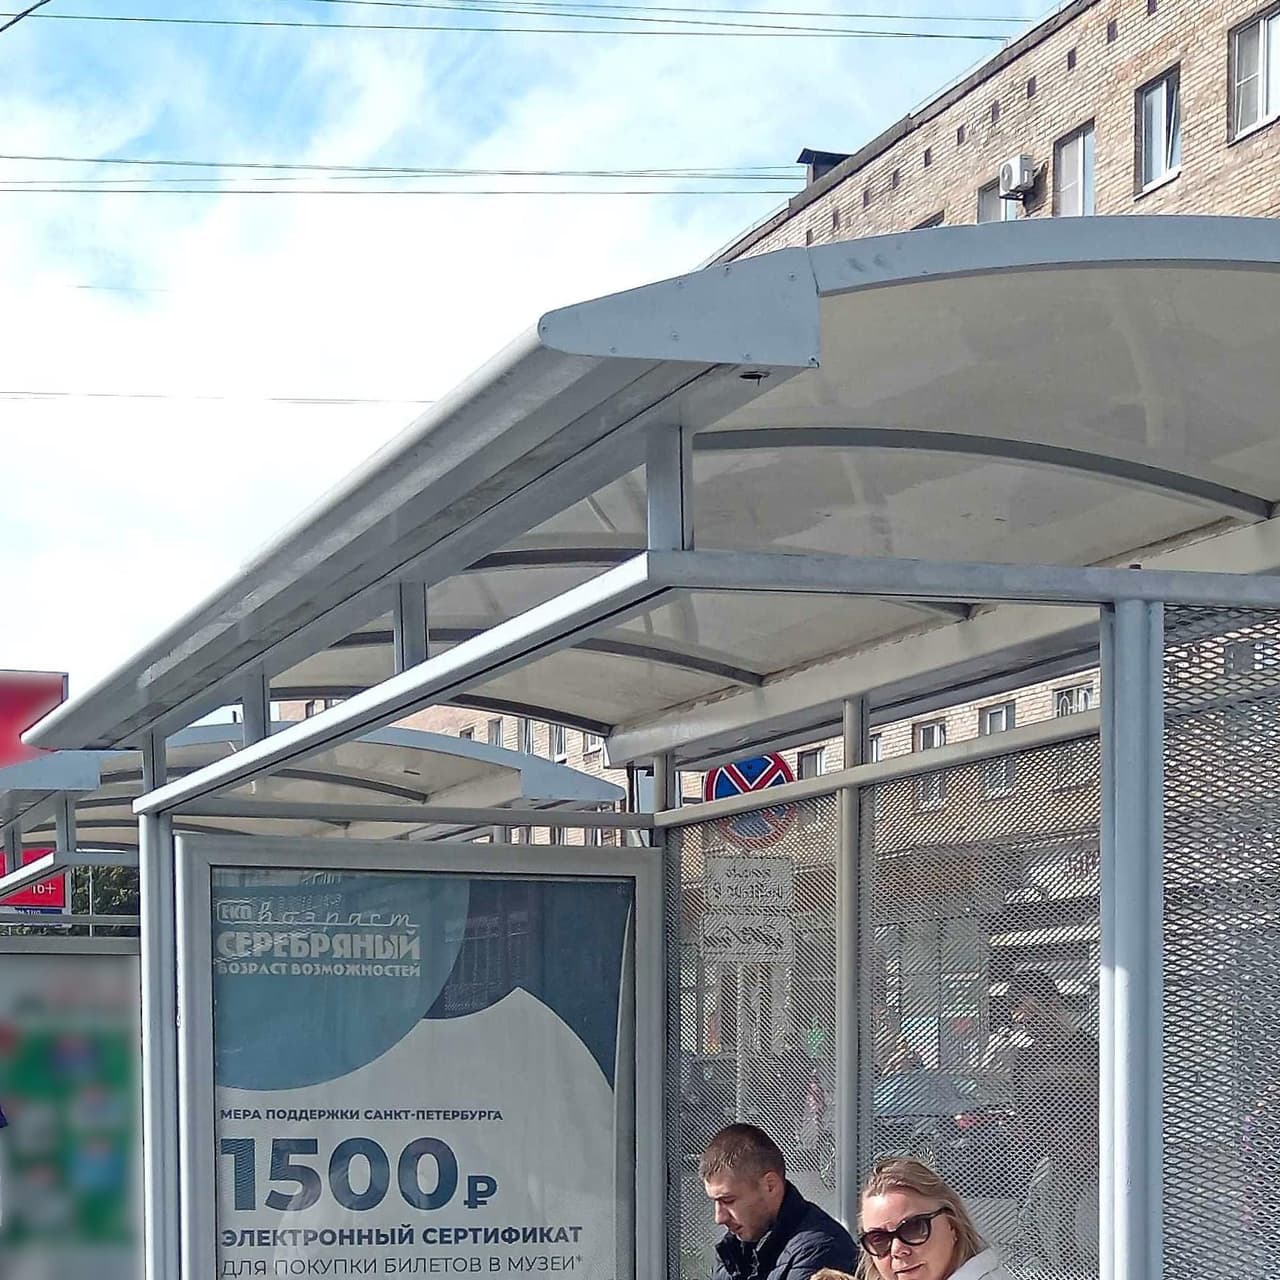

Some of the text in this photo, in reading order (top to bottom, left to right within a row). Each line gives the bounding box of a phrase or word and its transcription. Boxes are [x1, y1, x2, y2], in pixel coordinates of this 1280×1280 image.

[217, 928, 421, 959] СЕРЕБРЯНЫЙ
[291, 962, 421, 977] ВОЗМОЖНОСТЕЙ
[220, 1109, 504, 1122] МЕРА ПОДДЕРЖКИ САНКТ-ПЕТЕРБУРГА
[221, 1223, 583, 1248] ЭЛЕКТРОННЫЙ СЕРТИФИКАТ
[221, 1260, 268, 1279] ДЛЯ
[275, 1258, 377, 1276] ПОКУПКИ
[384, 1257, 482, 1274] БИЛЕТОВ
[489, 1257, 501, 1273] В
